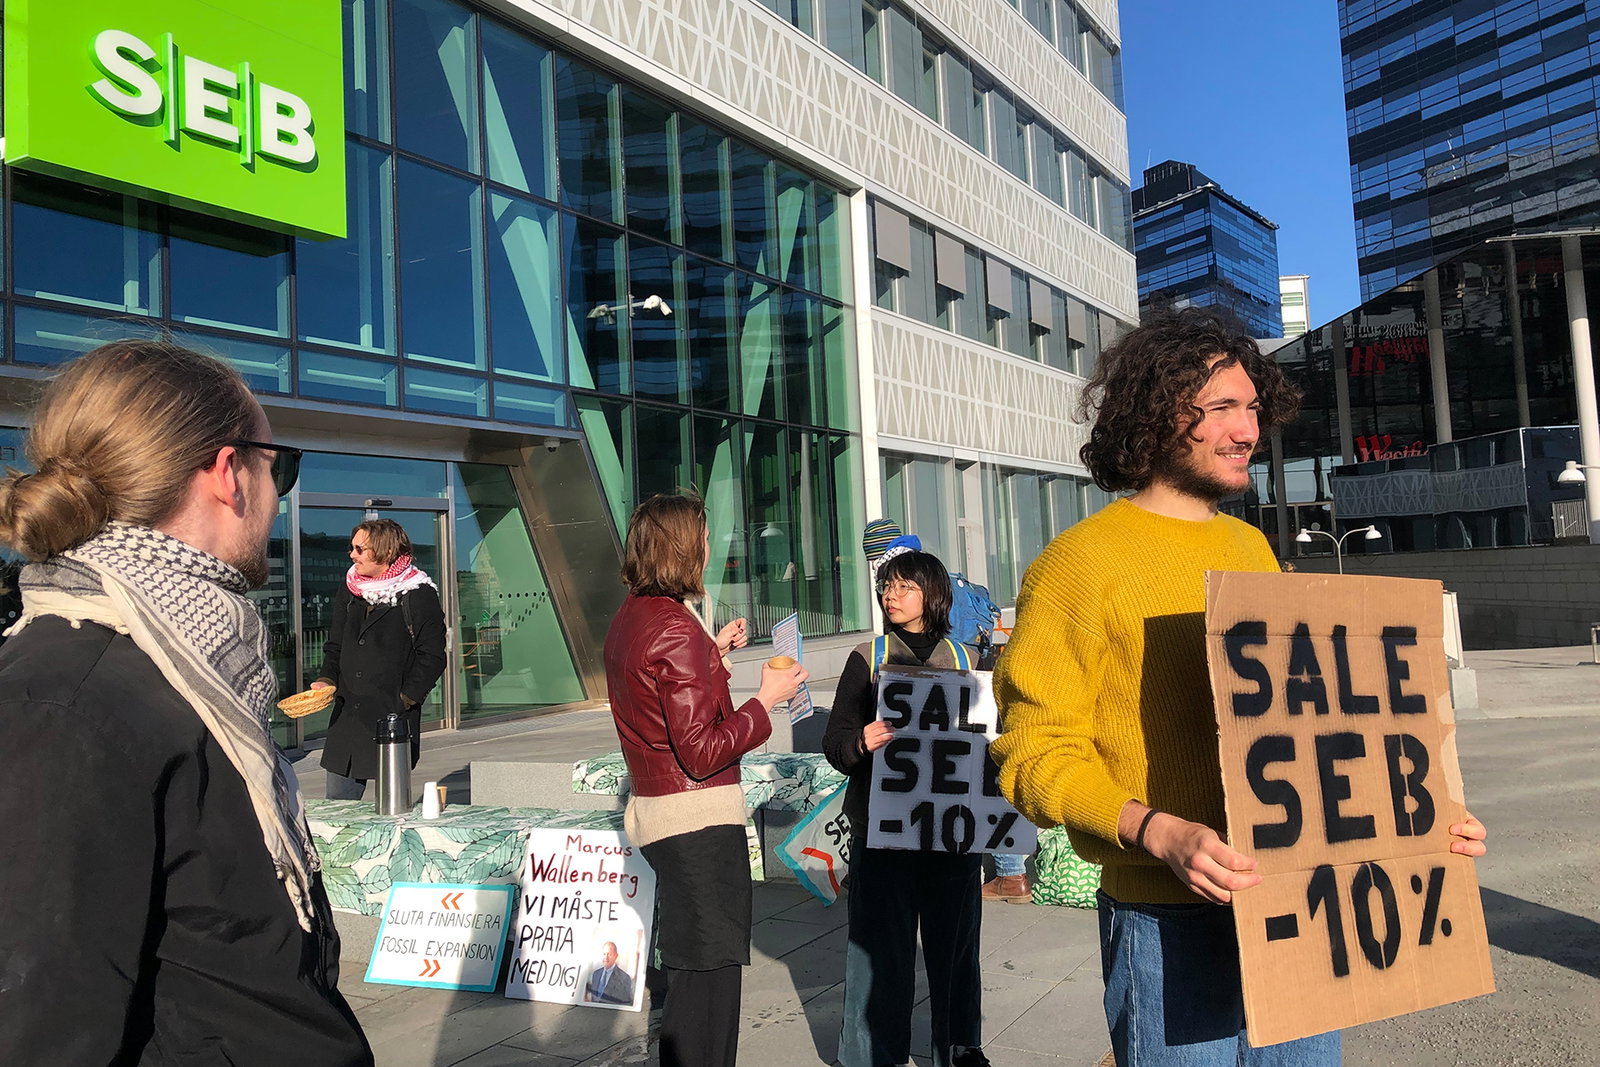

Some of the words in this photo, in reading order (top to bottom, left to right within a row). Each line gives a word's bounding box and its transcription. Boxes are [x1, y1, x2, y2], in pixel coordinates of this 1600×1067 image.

[87, 29, 318, 168] SEB
[1224, 621, 1427, 717] SALE
[882, 682, 1003, 734] SAL
[1245, 731, 1436, 850] SEB
[565, 834, 633, 857] Marcus
[879, 801, 1019, 855] -10%
[530, 852, 639, 898] Wallenberg
[387, 909, 424, 926] SLUTA
[427, 911, 501, 930] FINANSIERA
[524, 894, 545, 917] VI
[551, 890, 619, 923] MÅSTE
[1265, 862, 1453, 978] -10%
[379, 936, 418, 955] FOSSIL
[425, 940, 497, 961] EXPANSION
[518, 924, 574, 954] PRATA
[510, 957, 547, 985] MED
[548, 963, 582, 998] DIG!
